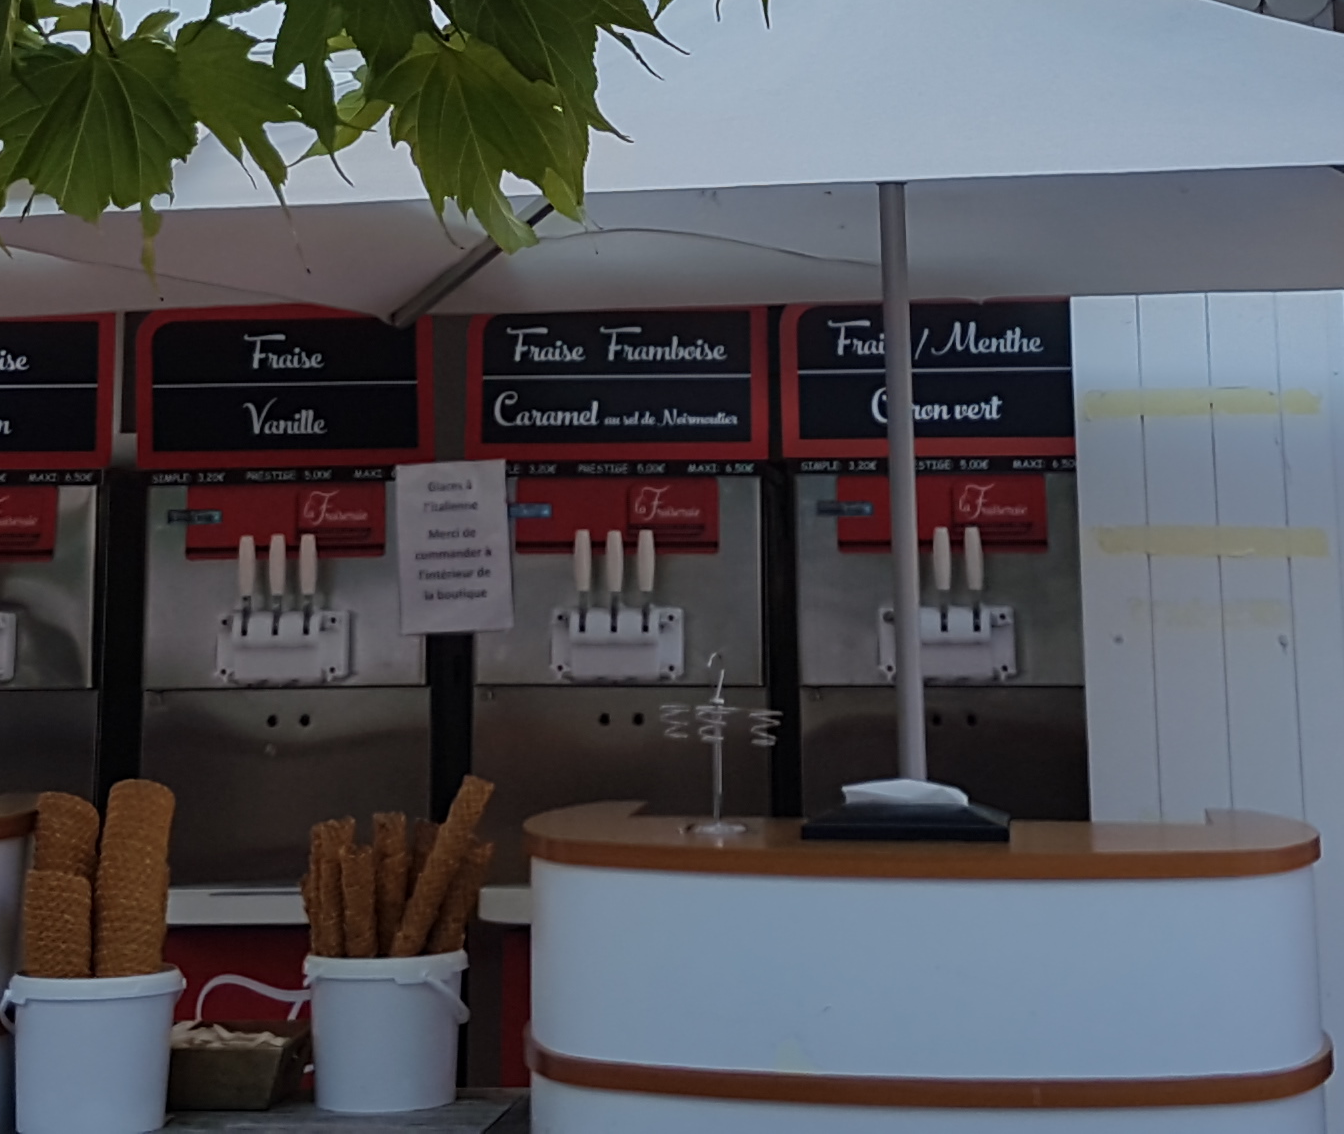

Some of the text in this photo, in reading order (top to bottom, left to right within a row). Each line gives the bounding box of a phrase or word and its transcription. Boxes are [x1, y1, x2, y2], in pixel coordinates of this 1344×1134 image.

[243, 333, 325, 369] Fraise
[506, 325, 728, 362] Fraise Framboise
[827, 319, 886, 356] Frai
[931, 321, 1044, 356] Menthe
[242, 397, 328, 435] Vanille
[493, 390, 738, 427] Caramel au sel de Noirmoutier
[870, 386, 1003, 424] Cron vert
[428, 528, 476, 539] Merci de
[415, 547, 482, 560] commander
[437, 587, 488, 601] boutique
